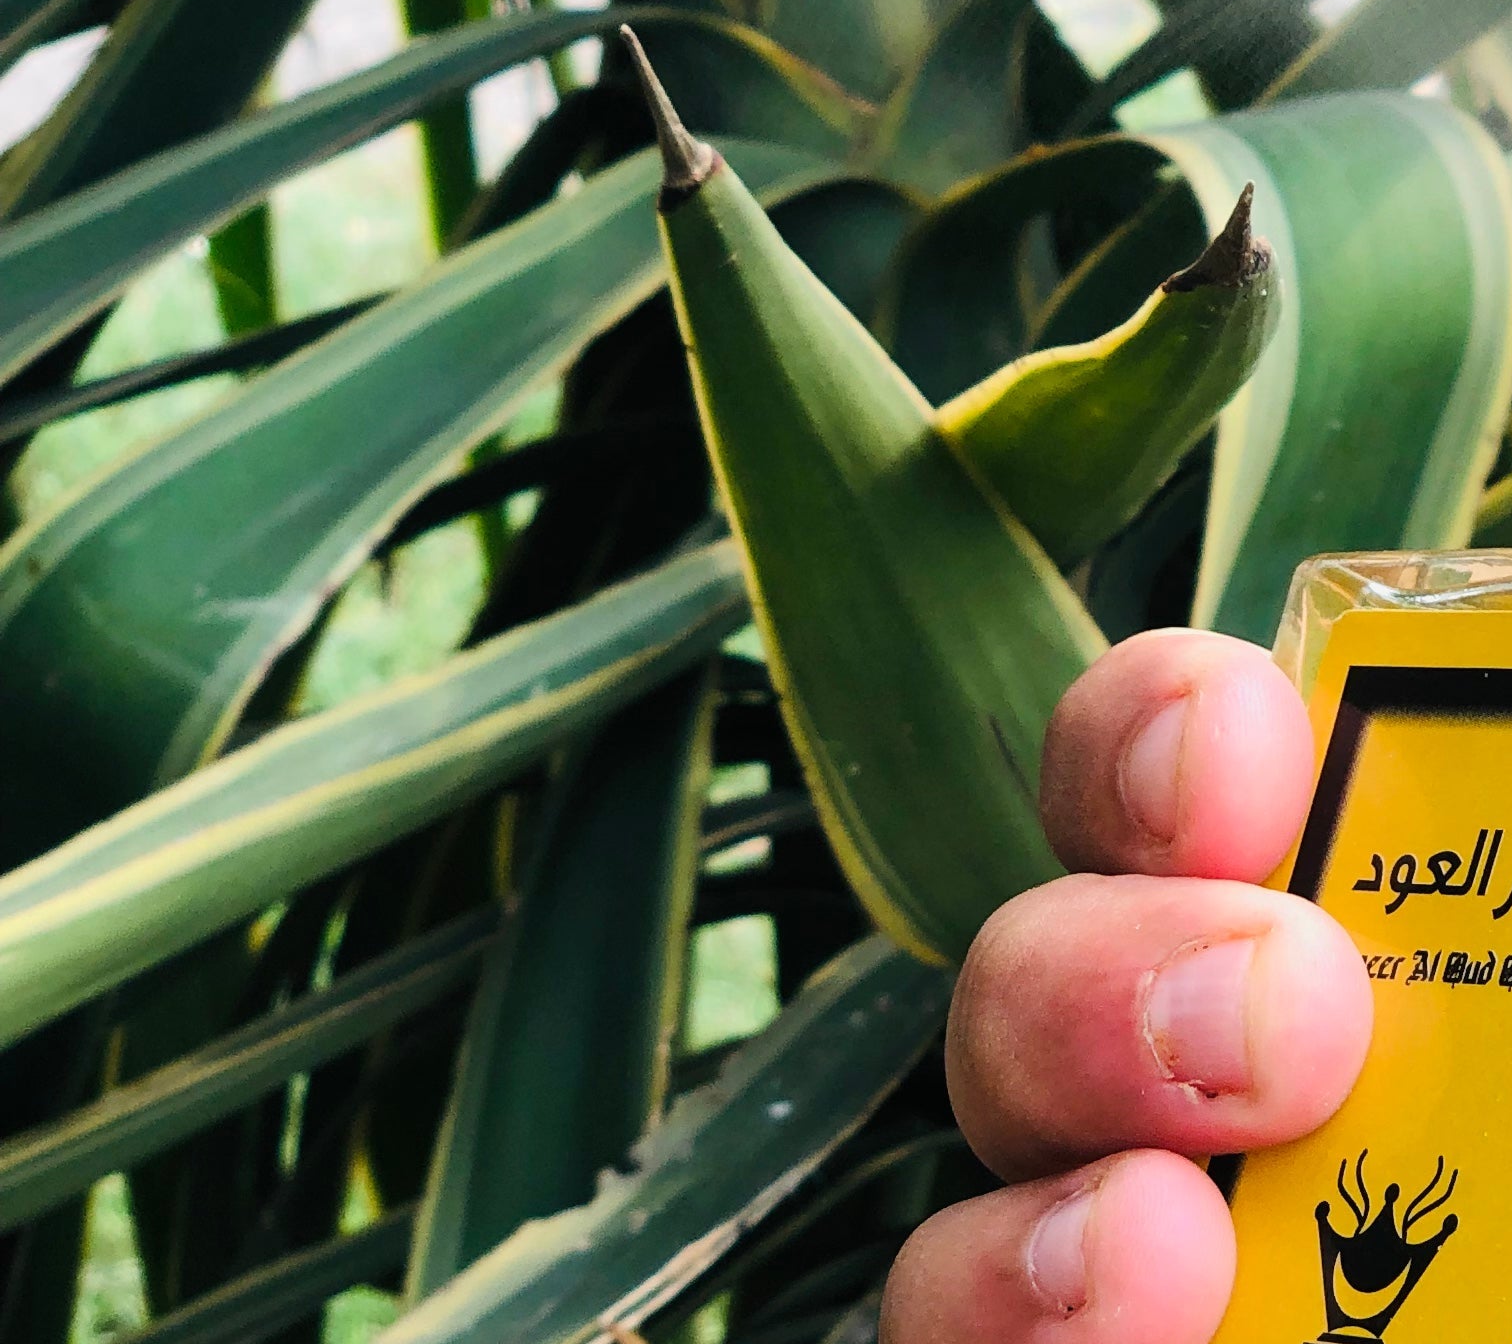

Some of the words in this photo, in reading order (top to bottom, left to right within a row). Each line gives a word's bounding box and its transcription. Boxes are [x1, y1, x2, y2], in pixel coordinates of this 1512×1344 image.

[1352, 828, 1504, 915] العود
[1405, 950, 1441, 986] Al
[1442, 950, 1496, 989] Oud
